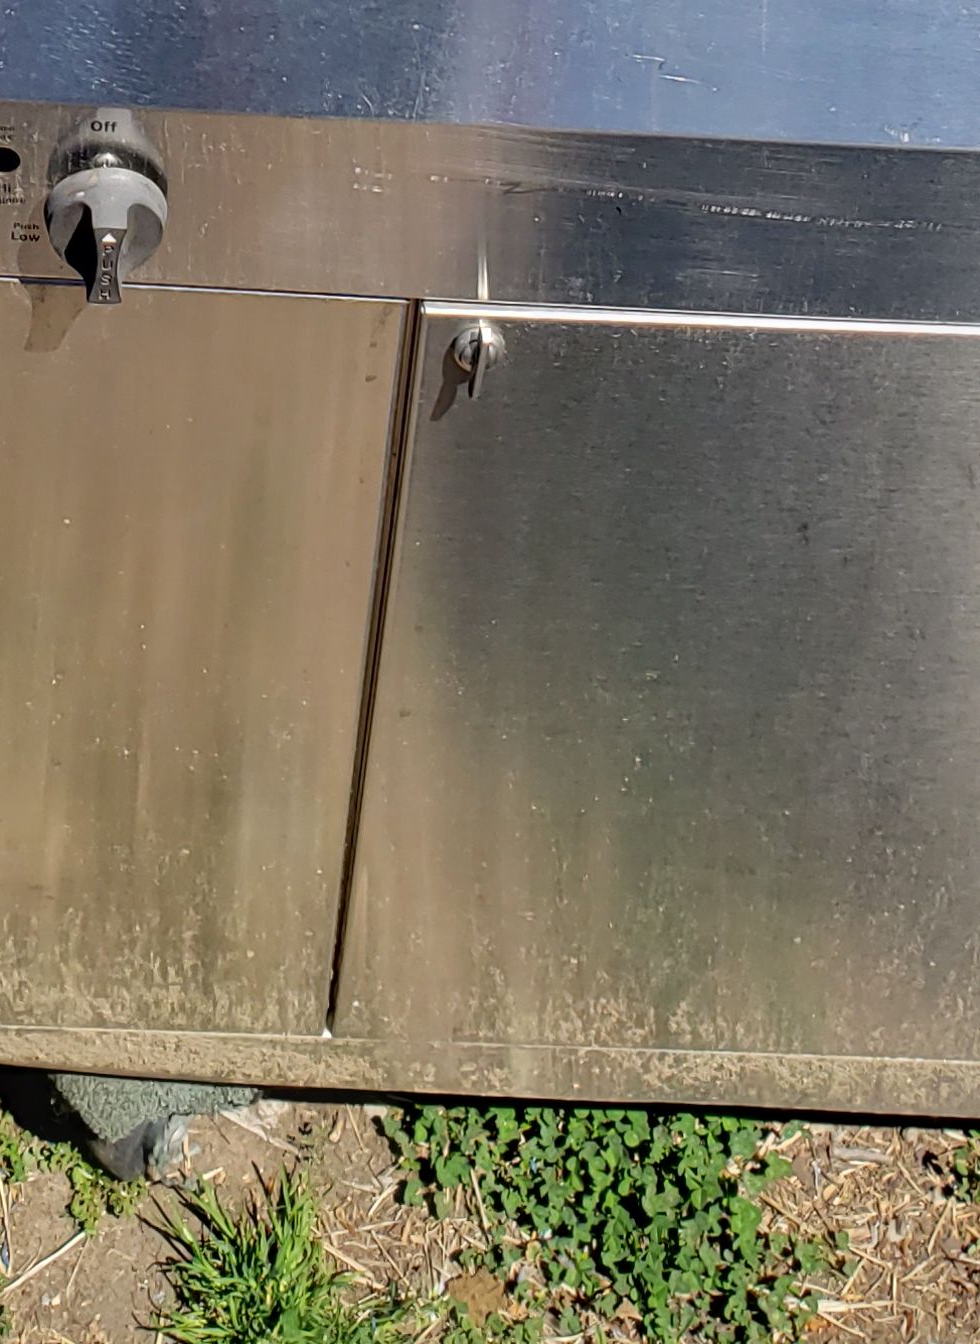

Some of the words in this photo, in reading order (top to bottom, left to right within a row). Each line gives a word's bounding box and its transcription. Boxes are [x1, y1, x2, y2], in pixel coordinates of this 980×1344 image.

[90, 120, 118, 133] Off
[13, 222, 40, 231] Push
[11, 231, 40, 243] Low
